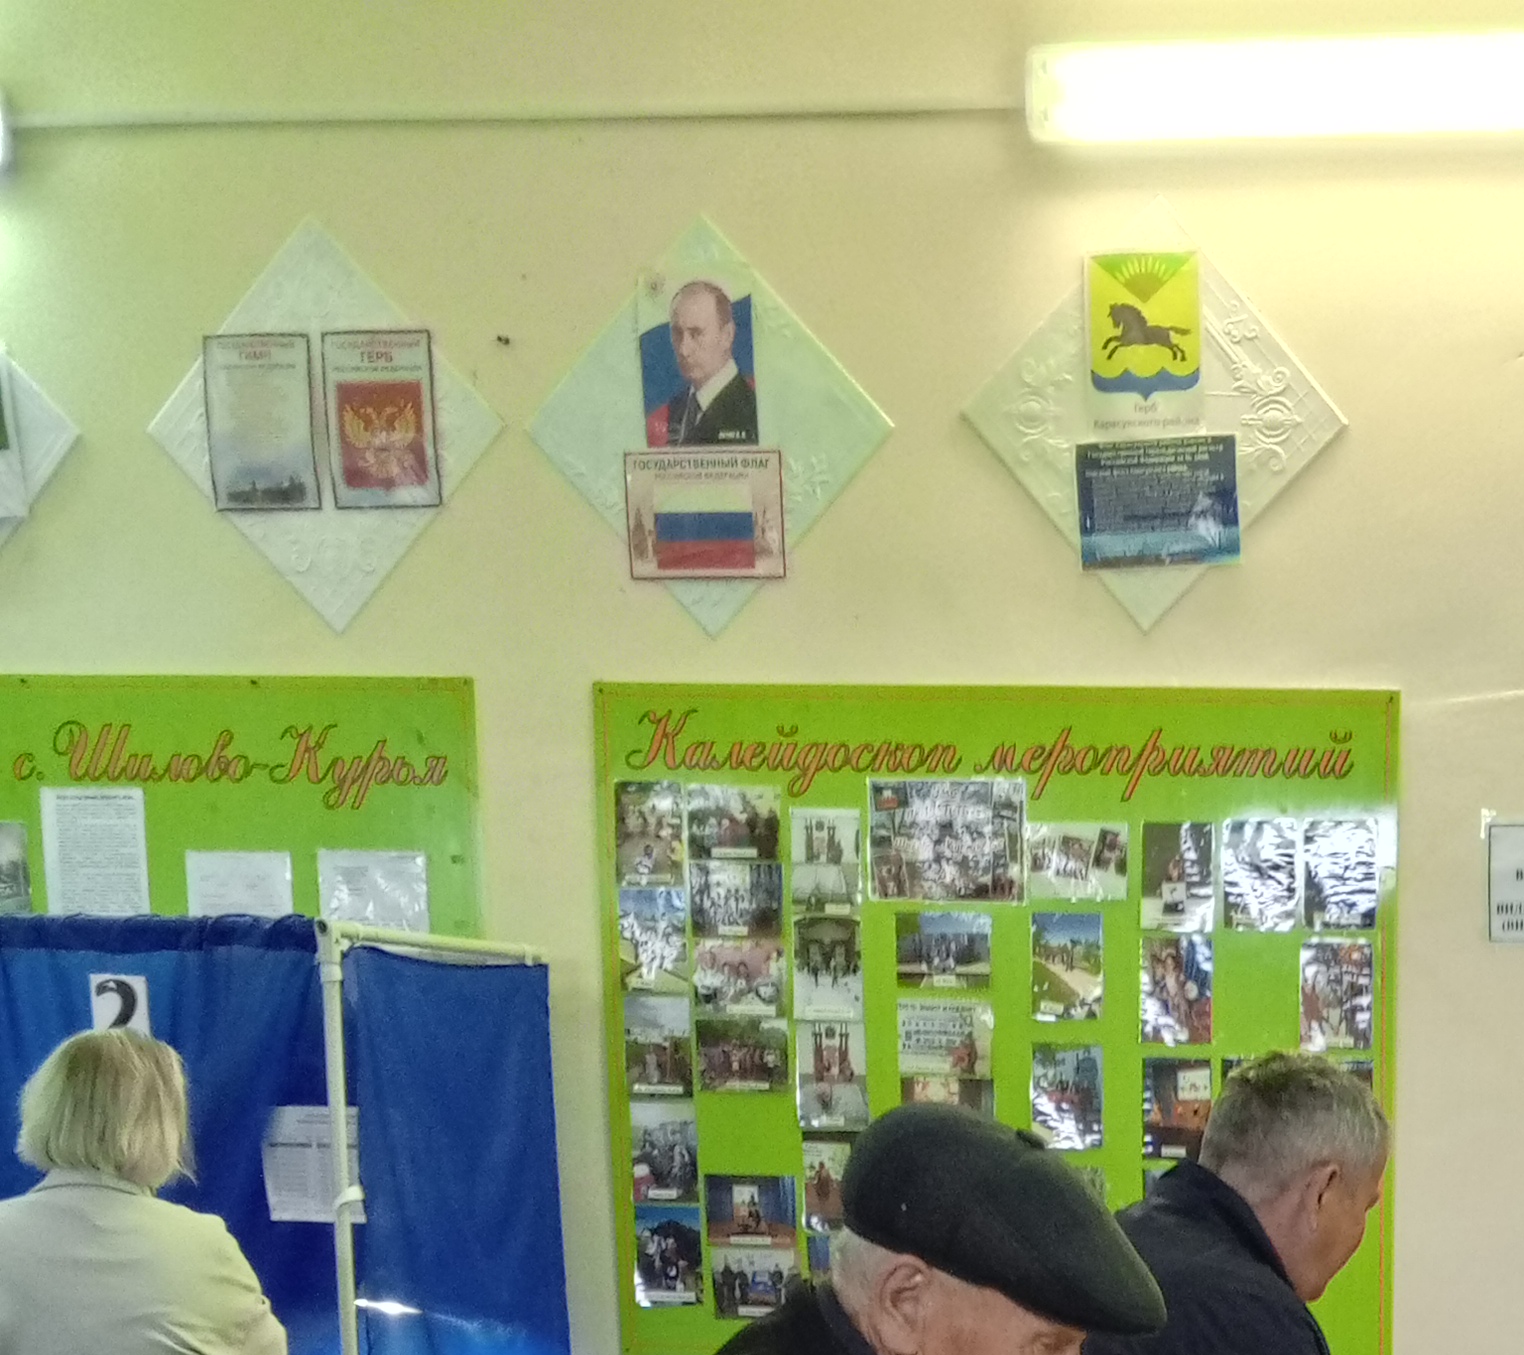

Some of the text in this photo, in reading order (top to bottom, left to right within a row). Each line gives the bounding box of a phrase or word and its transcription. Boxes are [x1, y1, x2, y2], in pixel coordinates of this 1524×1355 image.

[1134, 402, 1157, 414] Герб
[633, 458, 769, 471] ГОСУДАРСТВЕННЫЙ ФЛАГ
[53, 720, 449, 811] Шилово-Курья
[625, 708, 1356, 802] Калейдоскоп мероприятий
[1516, 868, 1523, 881] В
[95, 979, 137, 1029] 2
